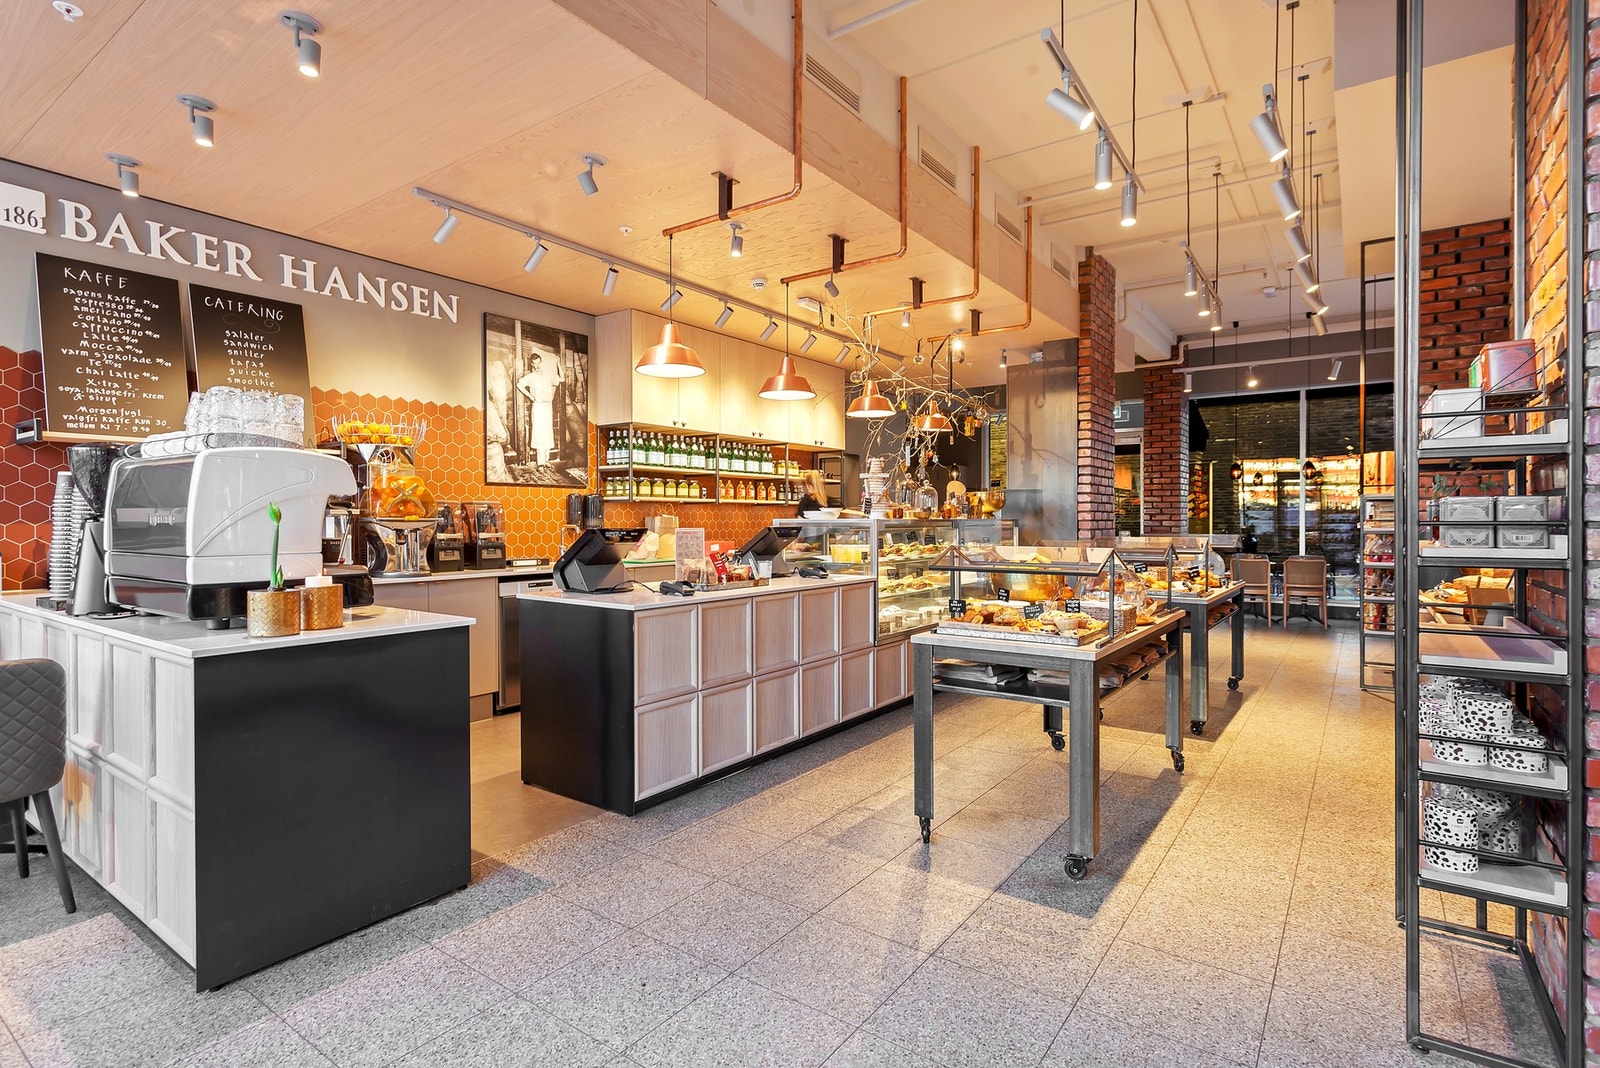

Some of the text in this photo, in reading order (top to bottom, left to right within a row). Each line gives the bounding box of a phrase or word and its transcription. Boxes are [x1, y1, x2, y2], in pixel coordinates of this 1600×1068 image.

[58, 198, 263, 282] BAKER
[279, 253, 460, 324] HANSEN
[64, 267, 128, 289] KAFFE
[74, 297, 124, 311] espresso
[204, 296, 284, 321] CATERING
[73, 305, 132, 319] americano
[72, 321, 144, 337] cappuccino
[79, 340, 124, 352] Mocca
[223, 339, 275, 351] sandwich
[60, 348, 89, 357] varm
[94, 351, 153, 364] sjokolade
[88, 358, 102, 367] Te
[230, 358, 264, 370] tapas
[226, 376, 275, 388] smoothie
[88, 394, 117, 406] sirup
[62, 413, 98, 423] valgfri
[66, 422, 96, 430] mellom
